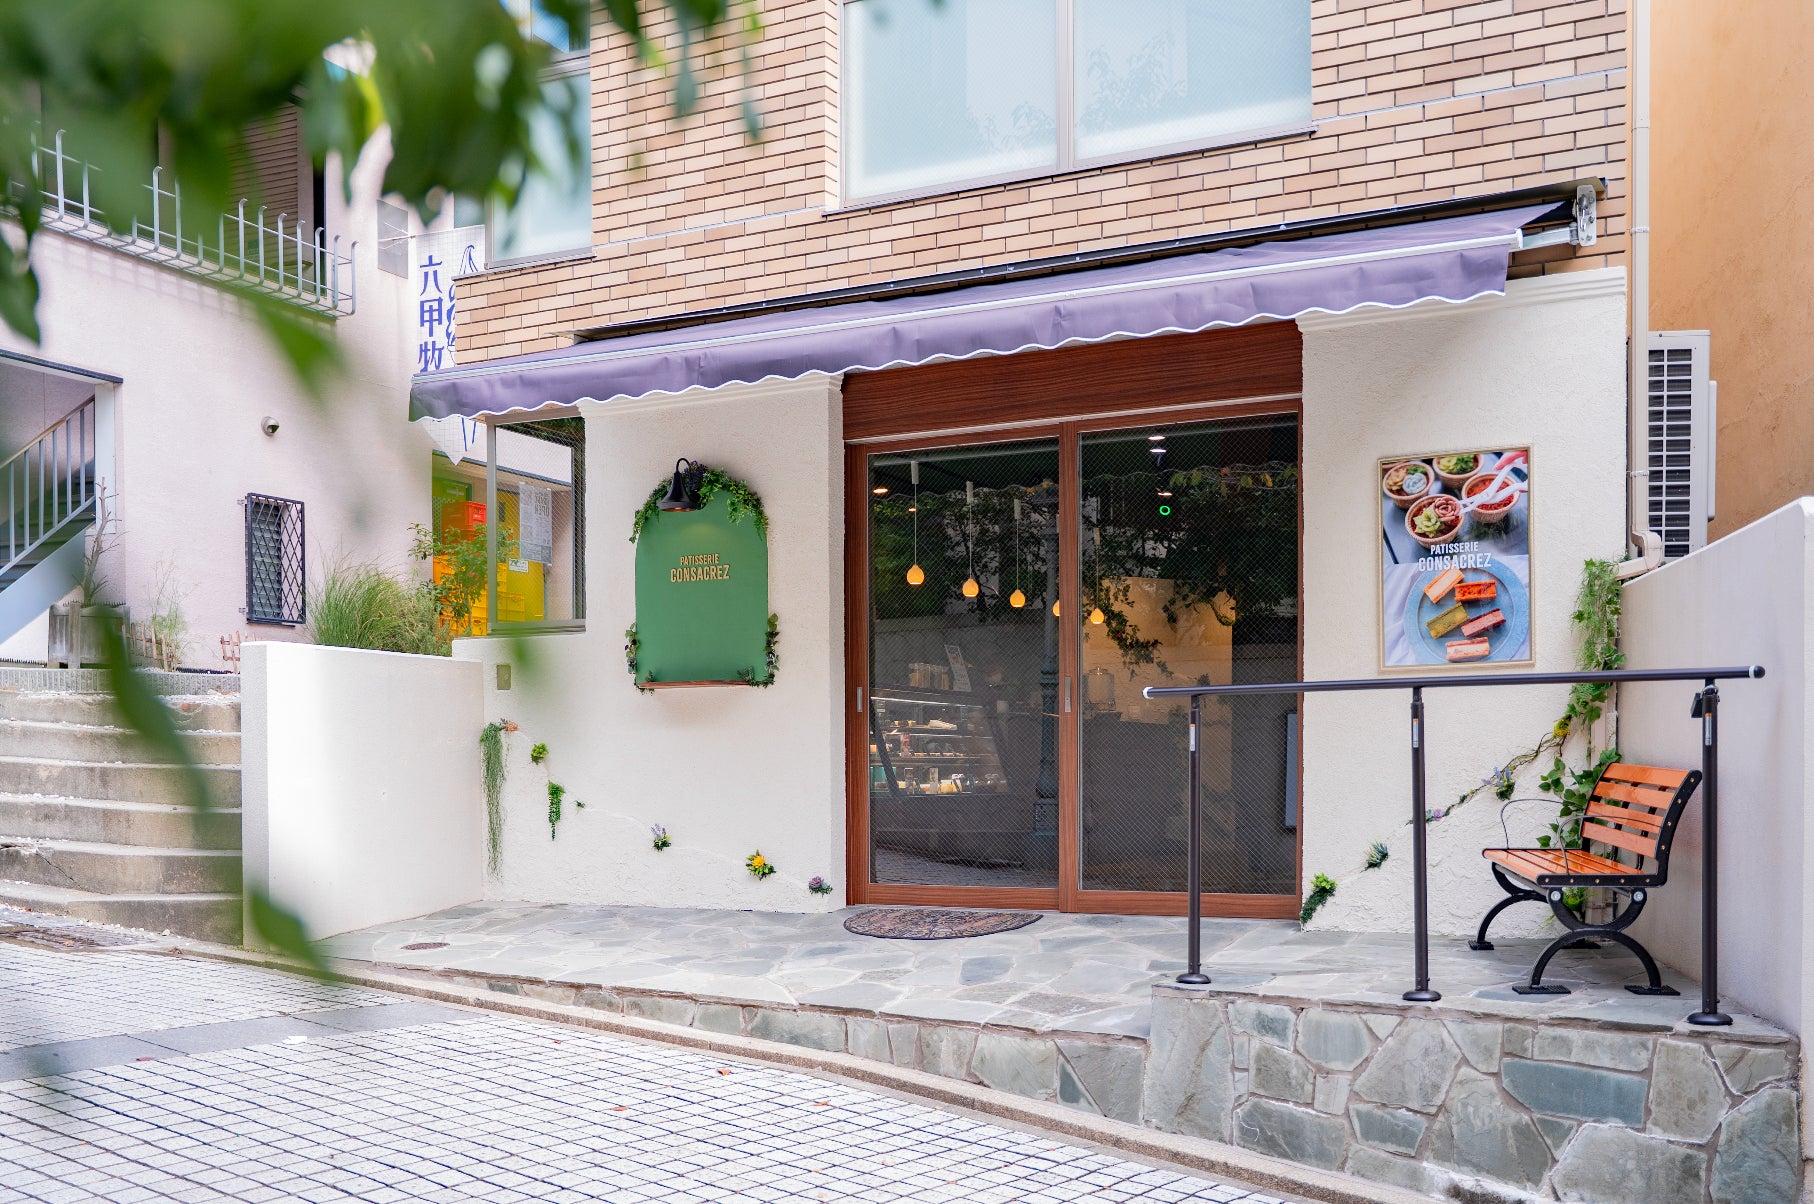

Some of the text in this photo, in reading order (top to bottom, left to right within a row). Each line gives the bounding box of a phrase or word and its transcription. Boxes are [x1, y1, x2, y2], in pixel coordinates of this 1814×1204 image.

[1430, 541, 1479, 555] PATISSERIE
[680, 553, 719, 566] PATISSERIE
[1418, 552, 1492, 572] CONSACREZ
[670, 564, 730, 583] CONSACREZ
